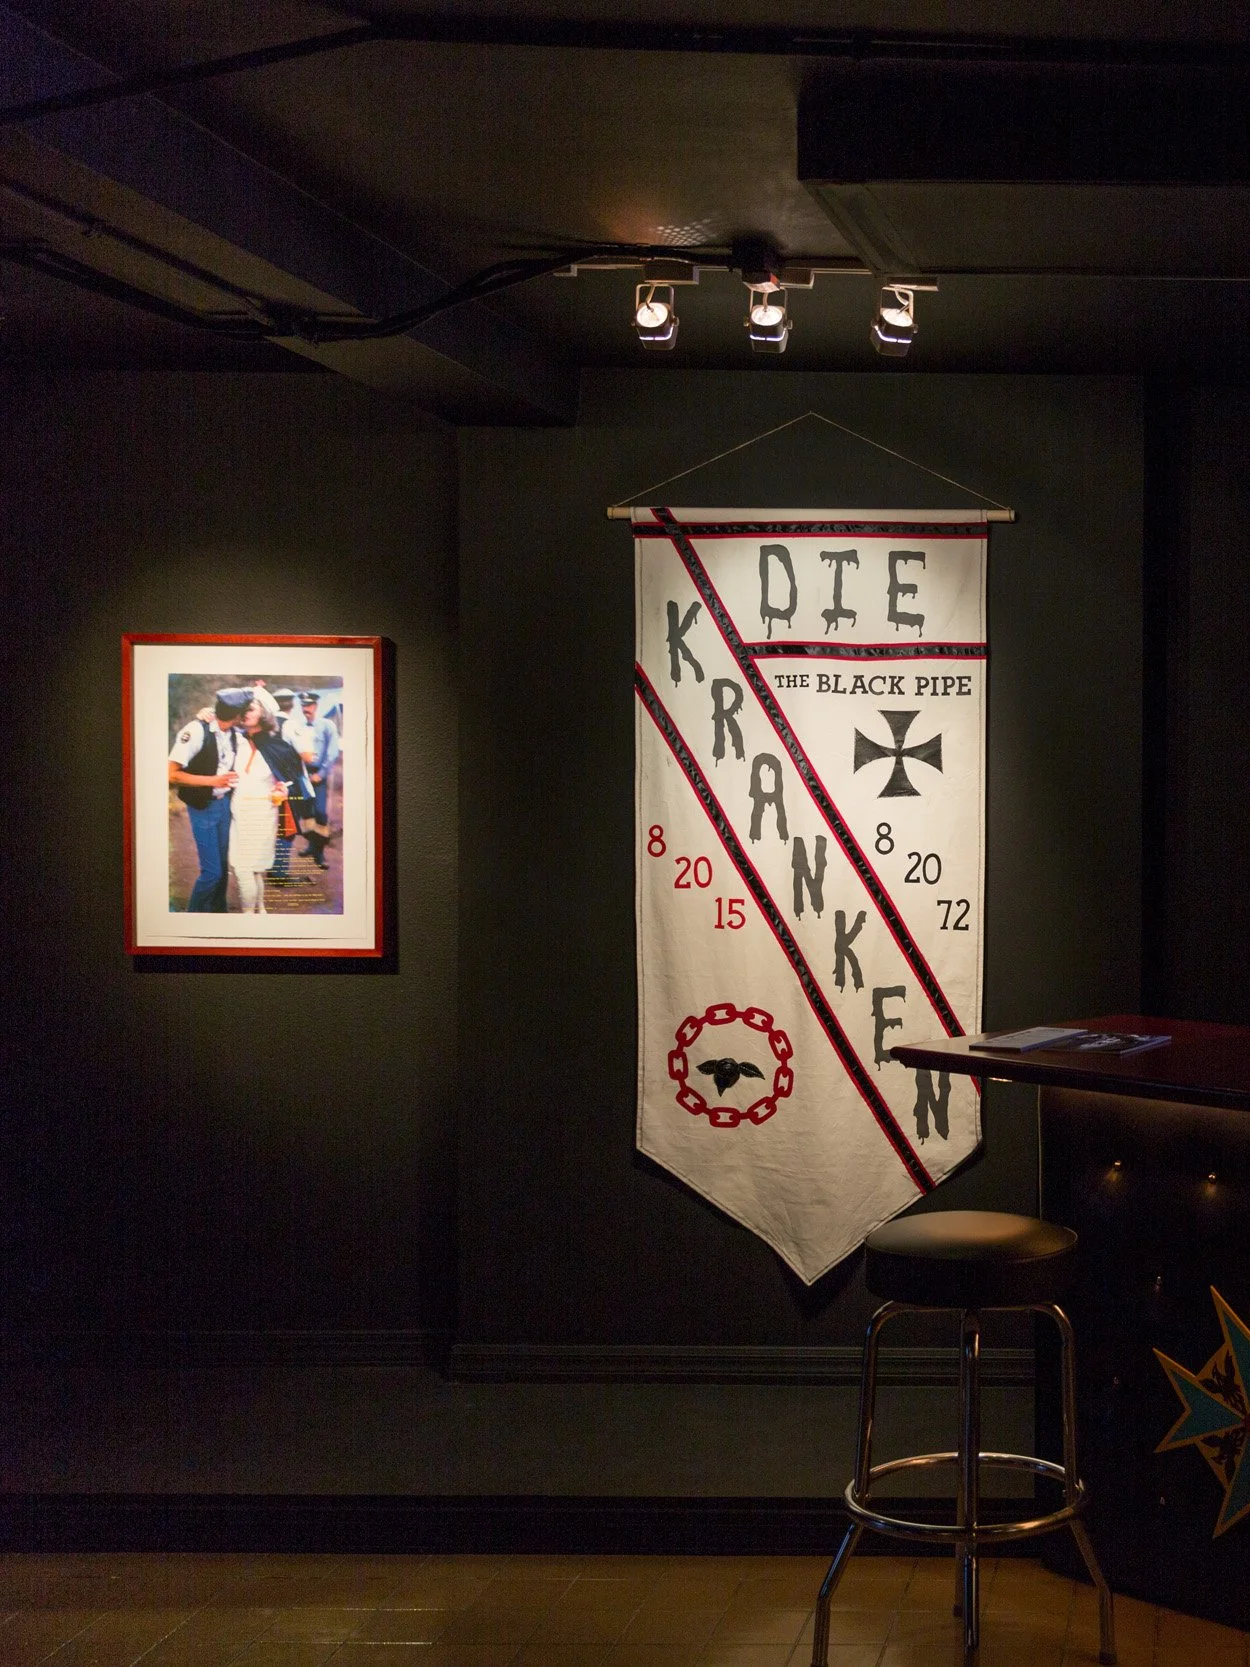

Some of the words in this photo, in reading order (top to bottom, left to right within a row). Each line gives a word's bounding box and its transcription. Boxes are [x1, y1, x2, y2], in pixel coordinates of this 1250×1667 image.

[759, 544, 926, 639] DIE
[774, 674, 810, 688] THE
[816, 674, 905, 695] BLACK
[914, 675, 972, 696] PIPE
[647, 824, 667, 857] 8
[874, 822, 895, 855] 8
[674, 856, 713, 889] 20
[904, 852, 942, 884] 20
[713, 897, 746, 929] 15
[936, 899, 970, 931] 72
